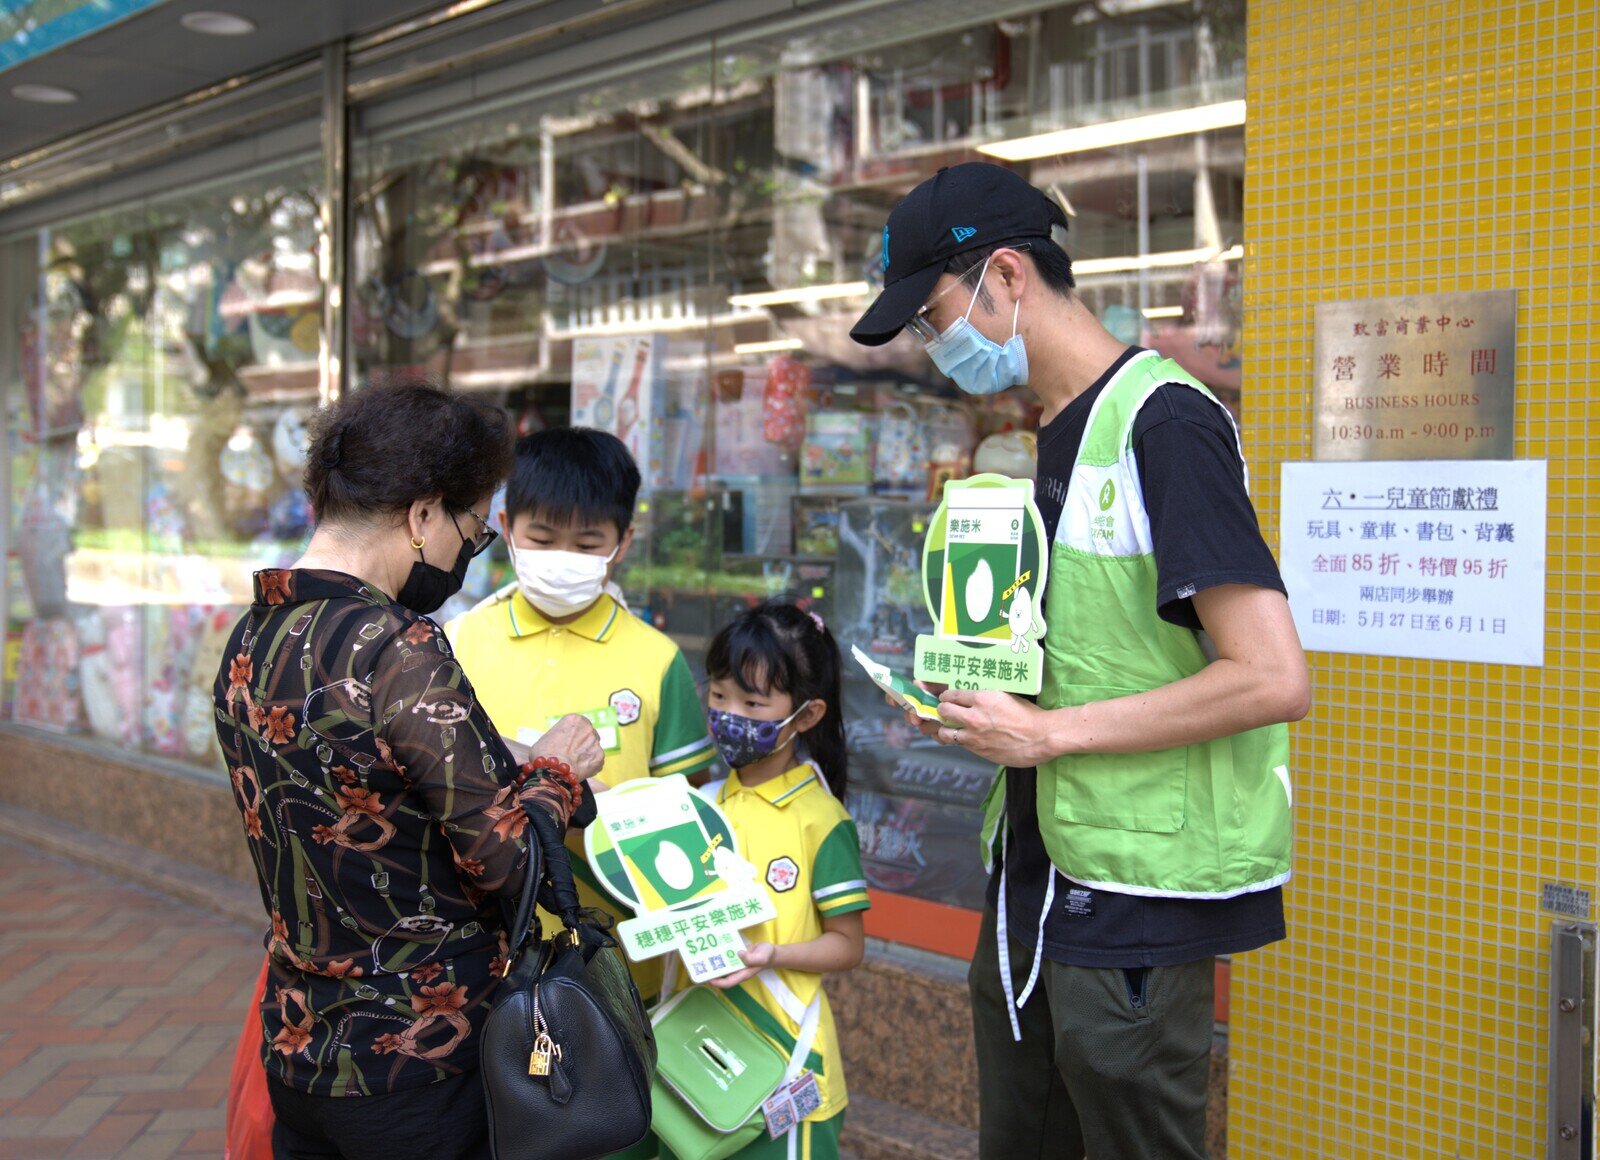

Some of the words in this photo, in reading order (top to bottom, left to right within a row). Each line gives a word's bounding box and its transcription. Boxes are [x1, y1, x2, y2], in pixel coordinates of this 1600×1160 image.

[1353, 315, 1475, 337] 致富商業中心
[1332, 349, 1497, 381] 營業時間
[1344, 396, 1419, 410] BUSINESS
[1425, 393, 1480, 407] HOURS
[1331, 425, 1373, 441] 10:30
[1376, 427, 1404, 440] a.m
[1423, 423, 1458, 438] 9:00
[1464, 424, 1495, 442] p.m
[949, 518, 981, 533] 樂施米
[1359, 585, 1454, 606] 兩店同步舉辦
[922, 651, 1029, 682] 穗穗平安樂施米
[634, 898, 763, 949] 穗穗平安樂施米
[685, 933, 718, 955] $20
